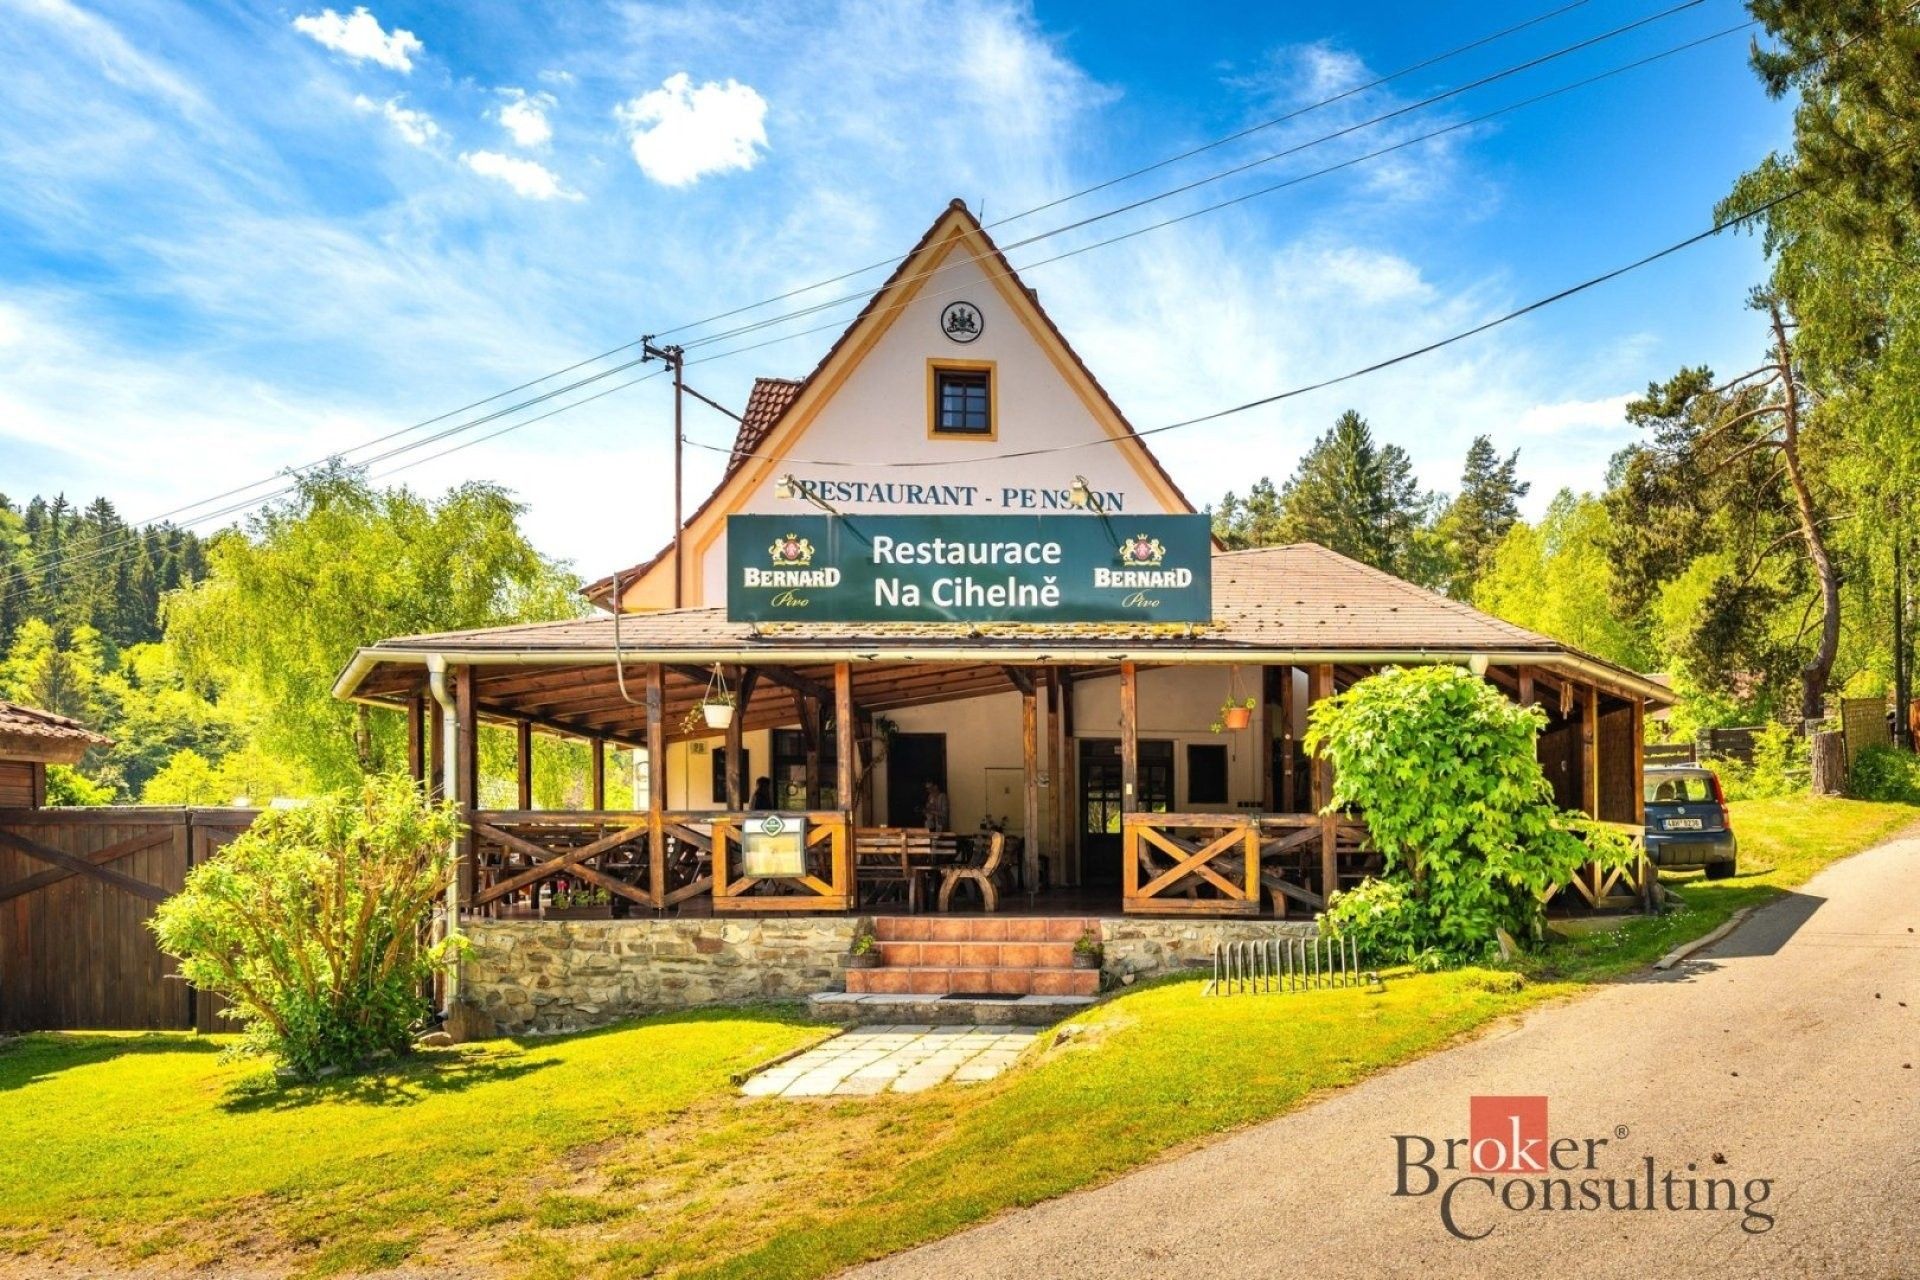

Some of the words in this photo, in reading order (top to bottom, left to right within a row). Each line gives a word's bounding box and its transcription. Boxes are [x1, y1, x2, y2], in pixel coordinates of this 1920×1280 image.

[800, 479, 977, 506] RESTAURANT
[1003, 487, 1124, 513] PENSON
[872, 535, 1062, 564] Restaurace
[743, 567, 841, 588] BERNARD
[1094, 567, 1192, 588] BERNARD
[770, 588, 809, 607] Pivo
[875, 578, 920, 606] Na
[931, 576, 1060, 607] Cihelně
[1121, 588, 1160, 608] Pivo
